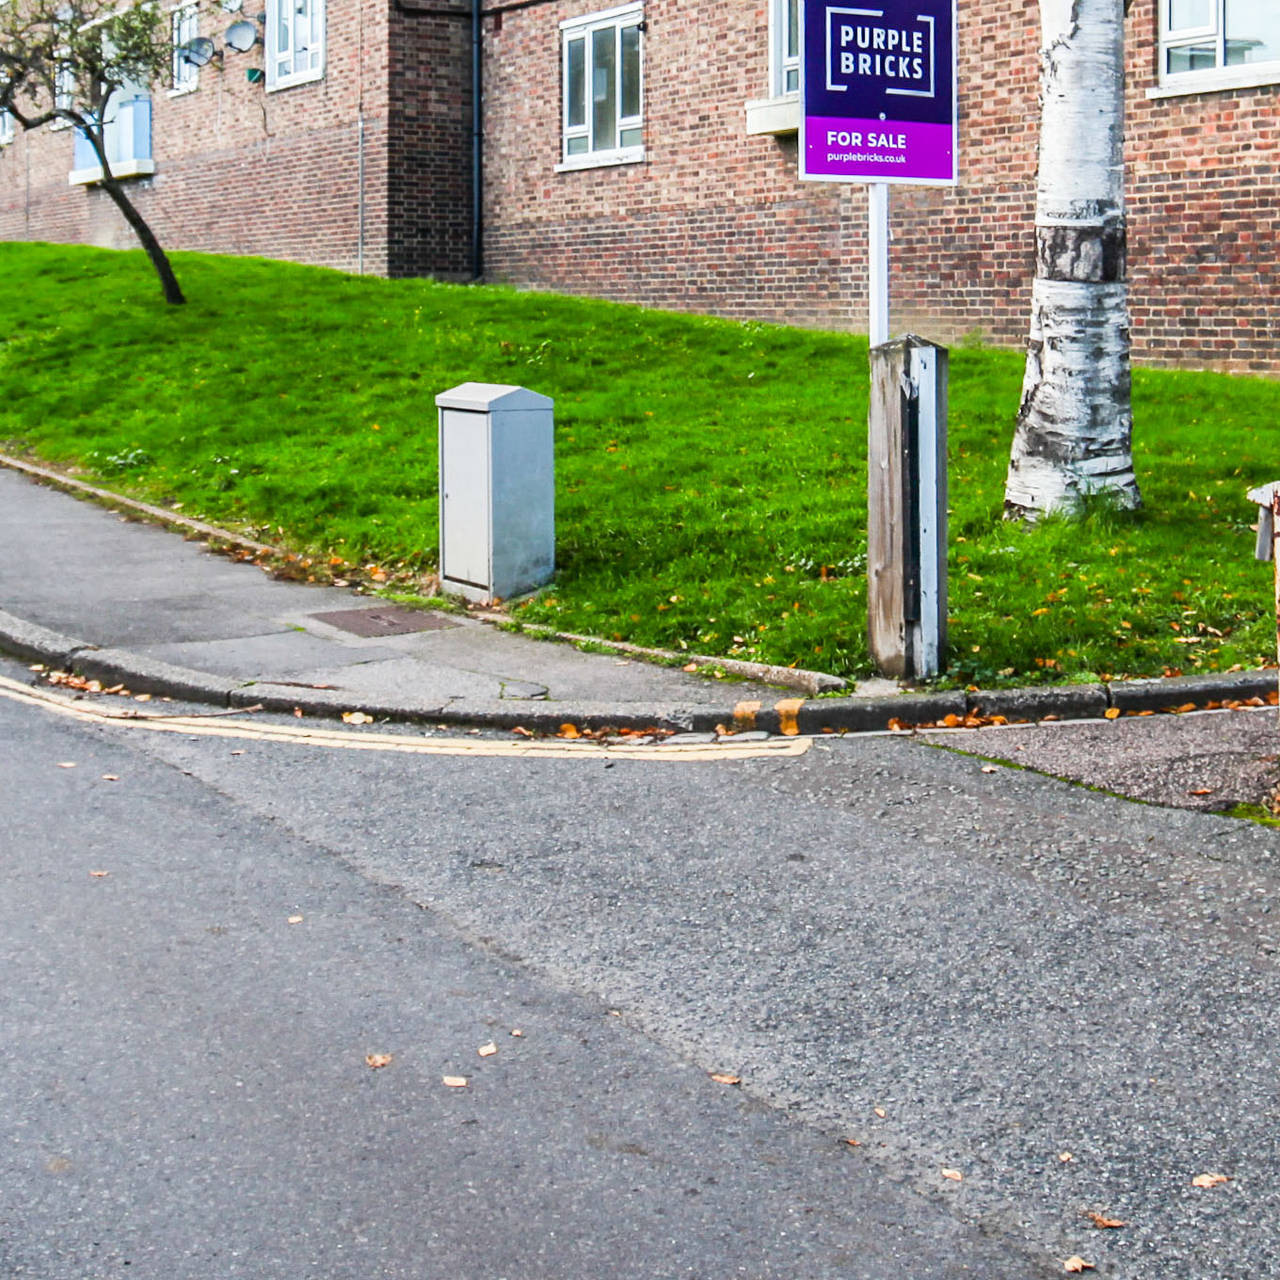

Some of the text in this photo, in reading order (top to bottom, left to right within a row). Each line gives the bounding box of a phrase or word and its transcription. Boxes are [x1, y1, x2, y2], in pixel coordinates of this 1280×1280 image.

[840, 25, 923, 53] PURPLE
[840, 52, 923, 79] BRICKS
[827, 131, 907, 149] FOR SALE
[827, 151, 907, 163] purplebricks.co.uk
